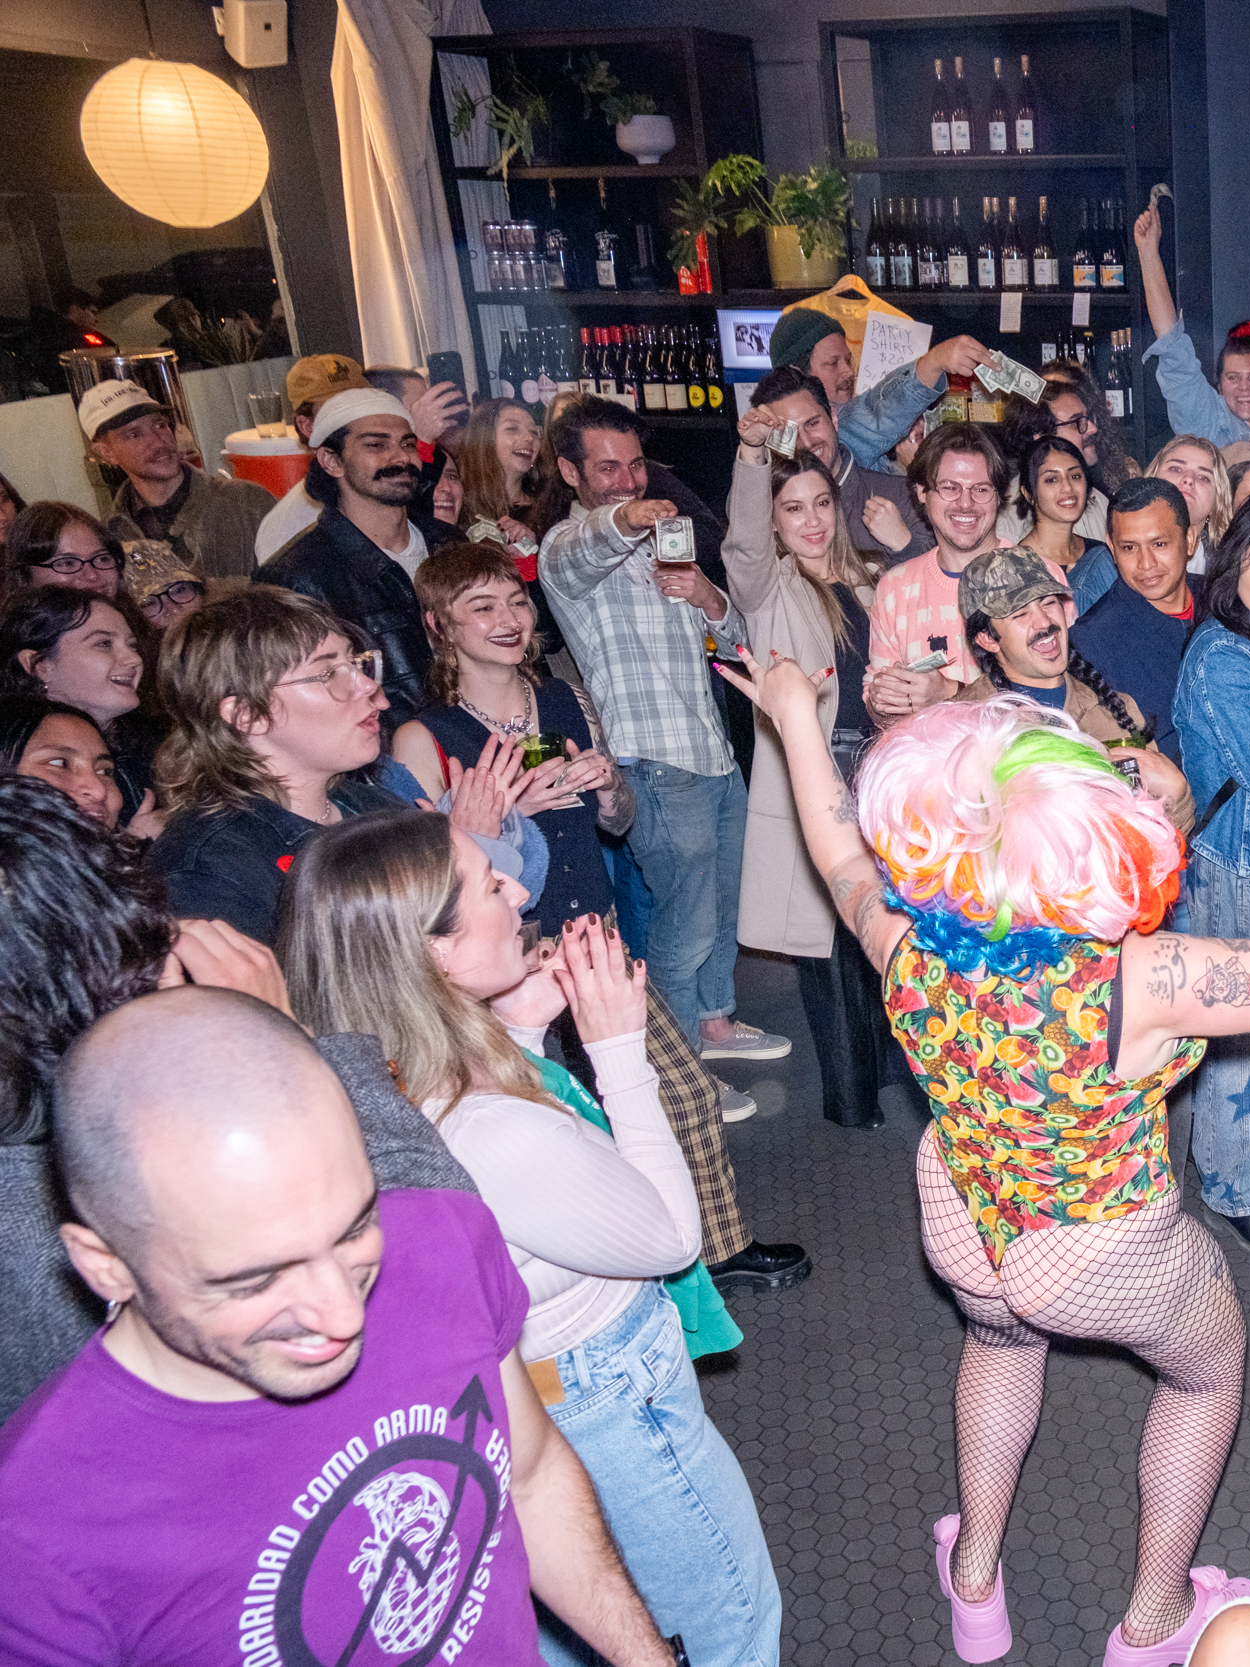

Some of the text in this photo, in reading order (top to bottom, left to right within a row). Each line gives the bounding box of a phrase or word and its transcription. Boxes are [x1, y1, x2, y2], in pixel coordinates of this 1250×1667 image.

[871, 320, 912, 344] PARTY
[871, 338, 914, 355] SHIRTS
[879, 352, 905, 365] $20
[292, 1436, 370, 1521] COMO
[374, 1404, 449, 1448] ARMA
[440, 1530, 502, 1667] RESISTE
